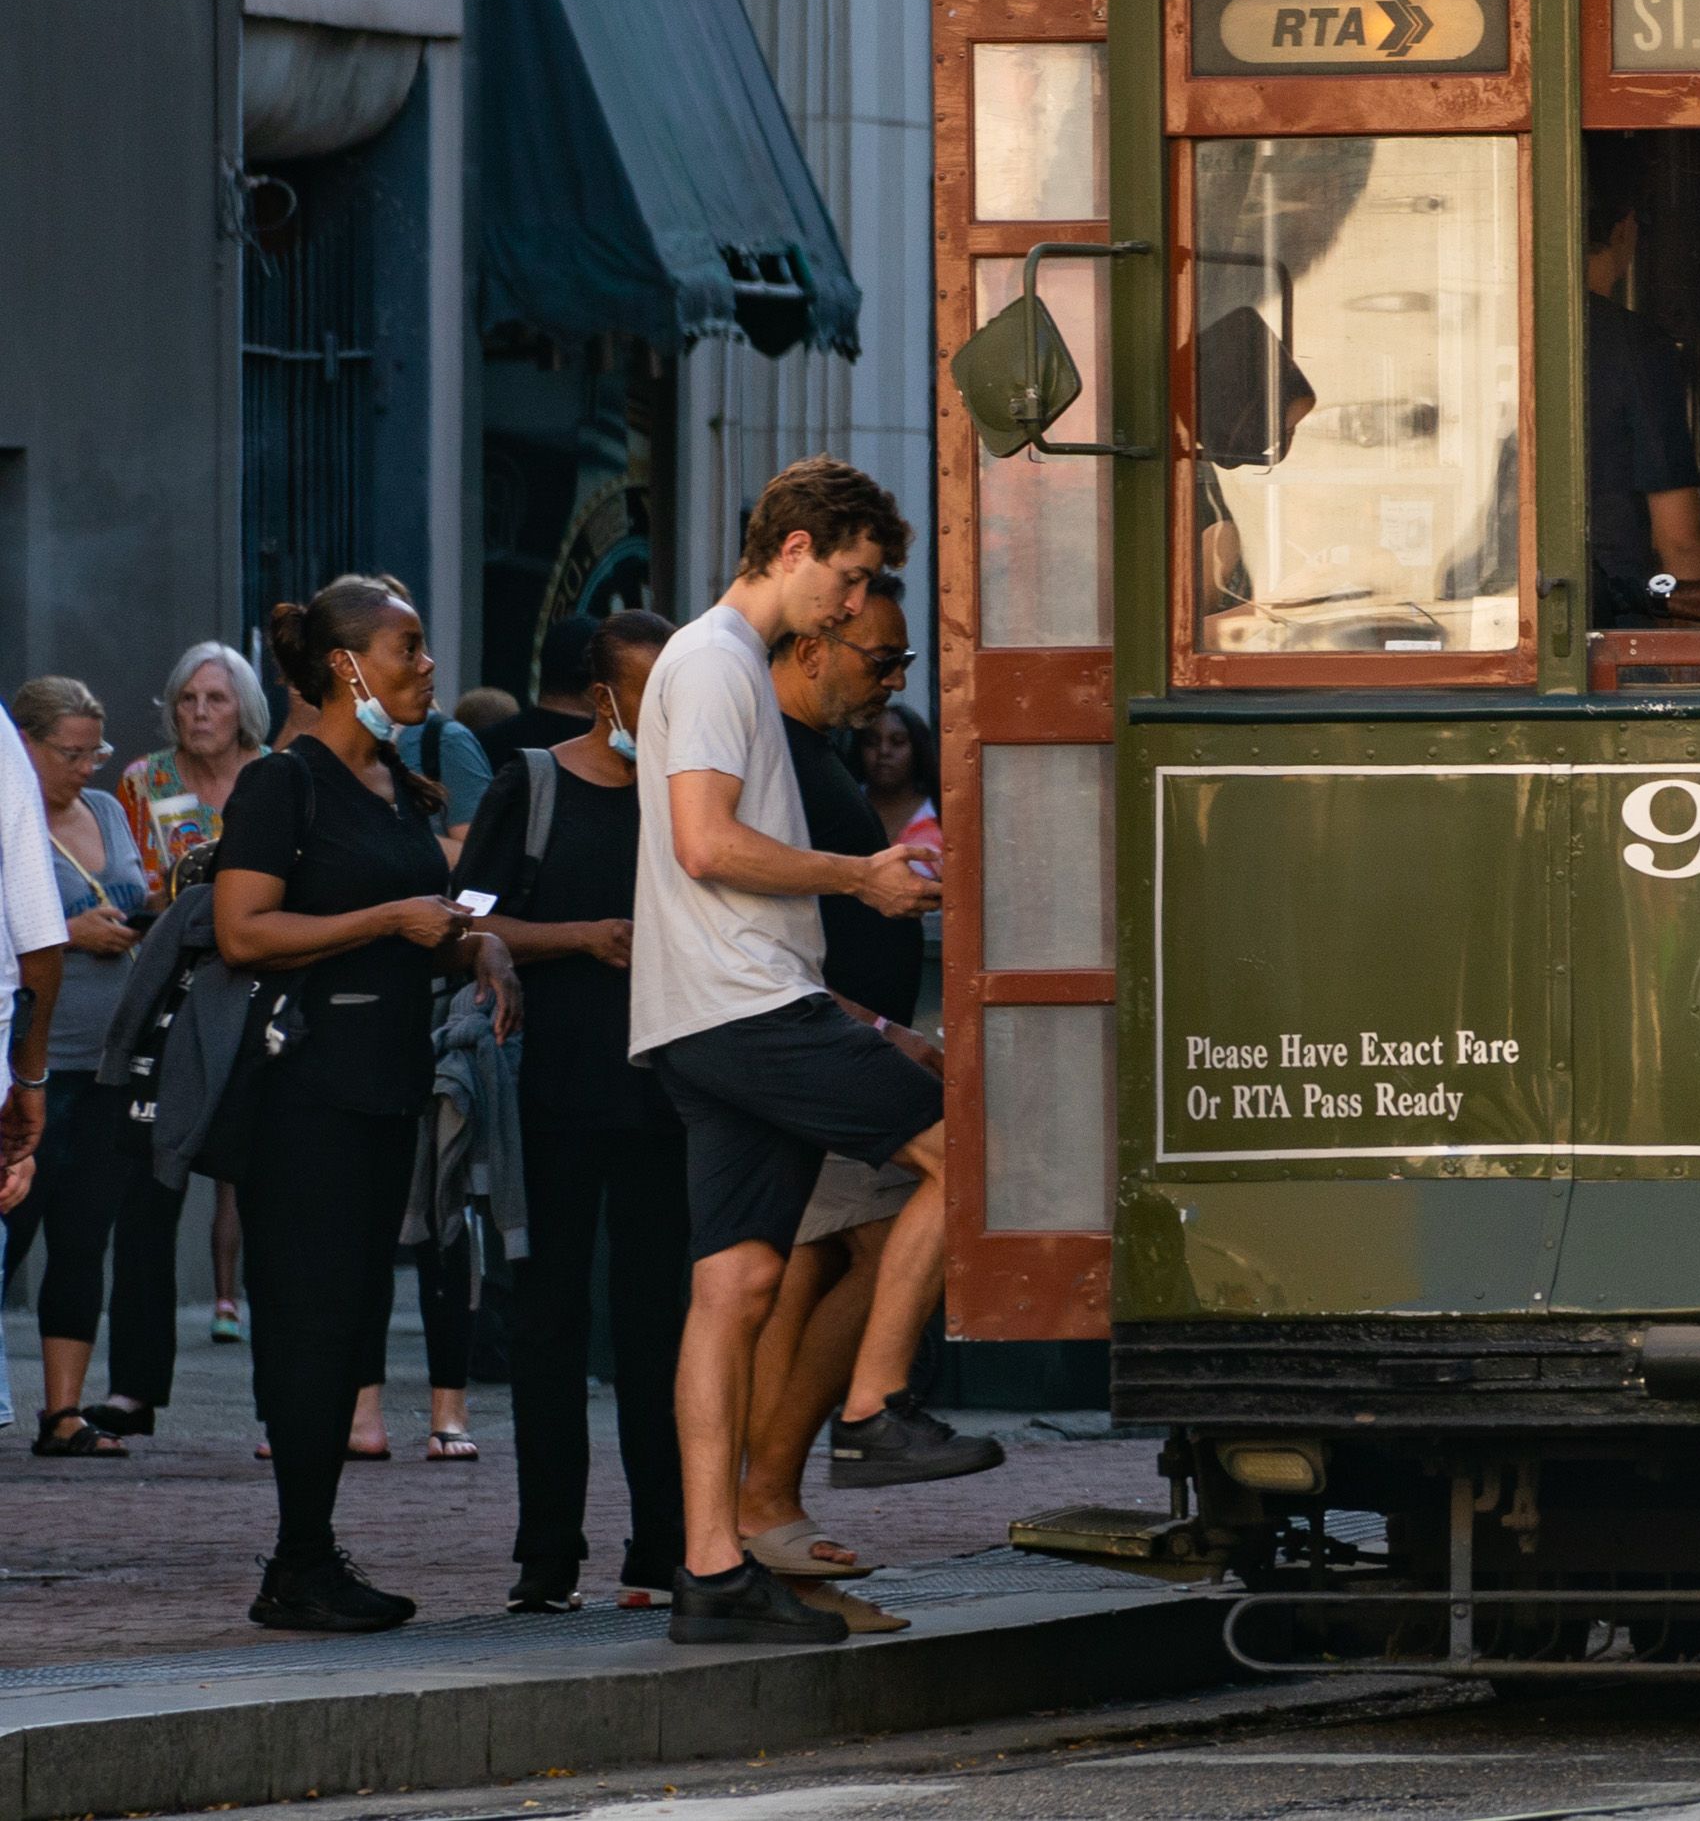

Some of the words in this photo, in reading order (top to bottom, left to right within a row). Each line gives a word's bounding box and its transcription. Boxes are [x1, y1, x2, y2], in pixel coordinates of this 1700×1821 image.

[1271, 7, 1367, 48] RTA
[1186, 1035, 1269, 1070] Please
[1279, 1033, 1349, 1068] Have
[1360, 1032, 1444, 1066] Exact
[1455, 1030, 1521, 1065] Fare
[1186, 1085, 1222, 1121] Or
[1232, 1084, 1292, 1119] RTA
[1302, 1083, 1363, 1118] Pass
[1374, 1082, 1464, 1122] Ready
